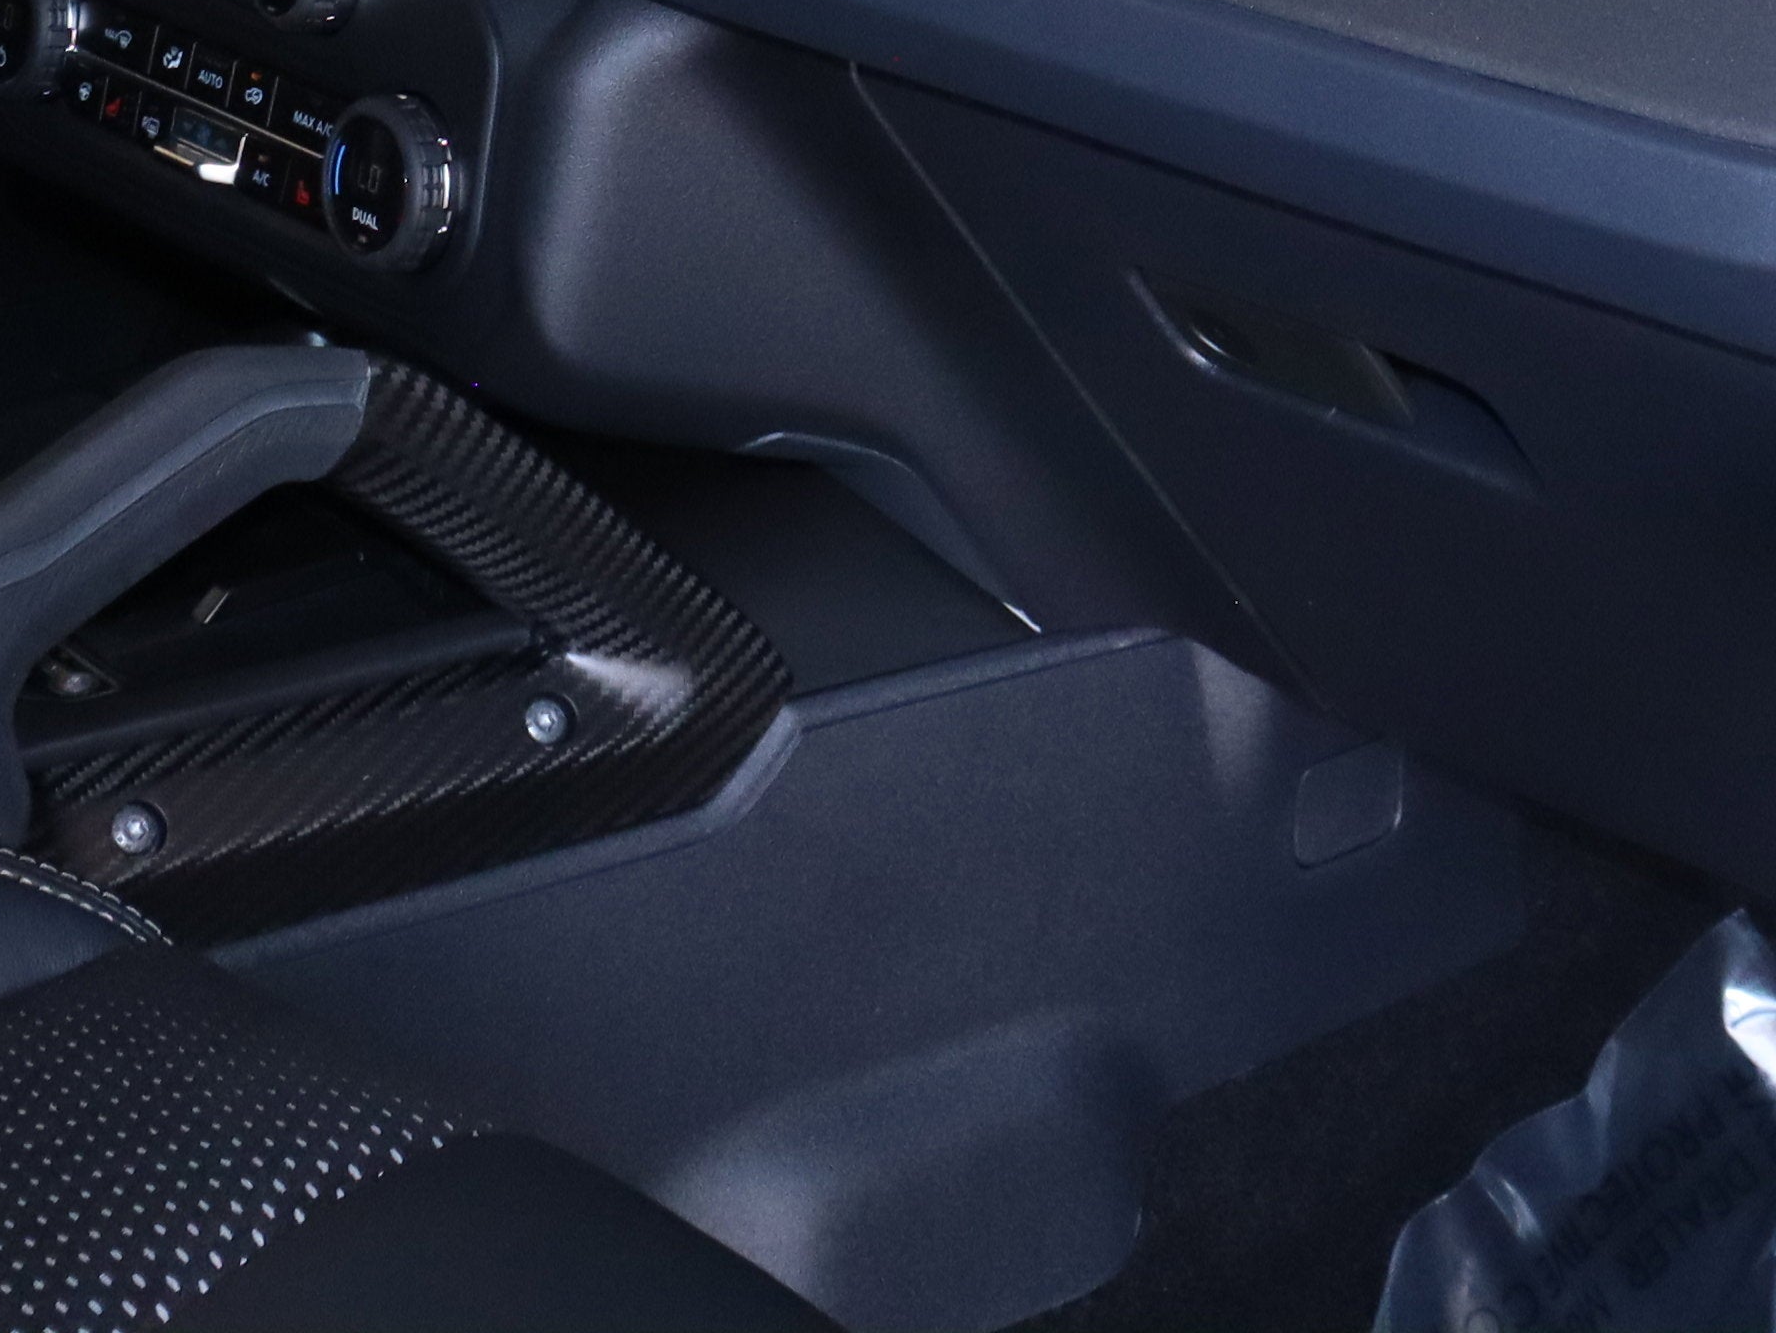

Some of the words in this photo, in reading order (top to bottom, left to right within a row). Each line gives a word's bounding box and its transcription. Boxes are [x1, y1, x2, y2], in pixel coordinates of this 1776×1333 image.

[197, 66, 224, 90] AUTO
[292, 110, 315, 128] MAX
[315, 118, 335, 138] A/C
[251, 169, 272, 188] A/C
[351, 206, 380, 232] DUAL
